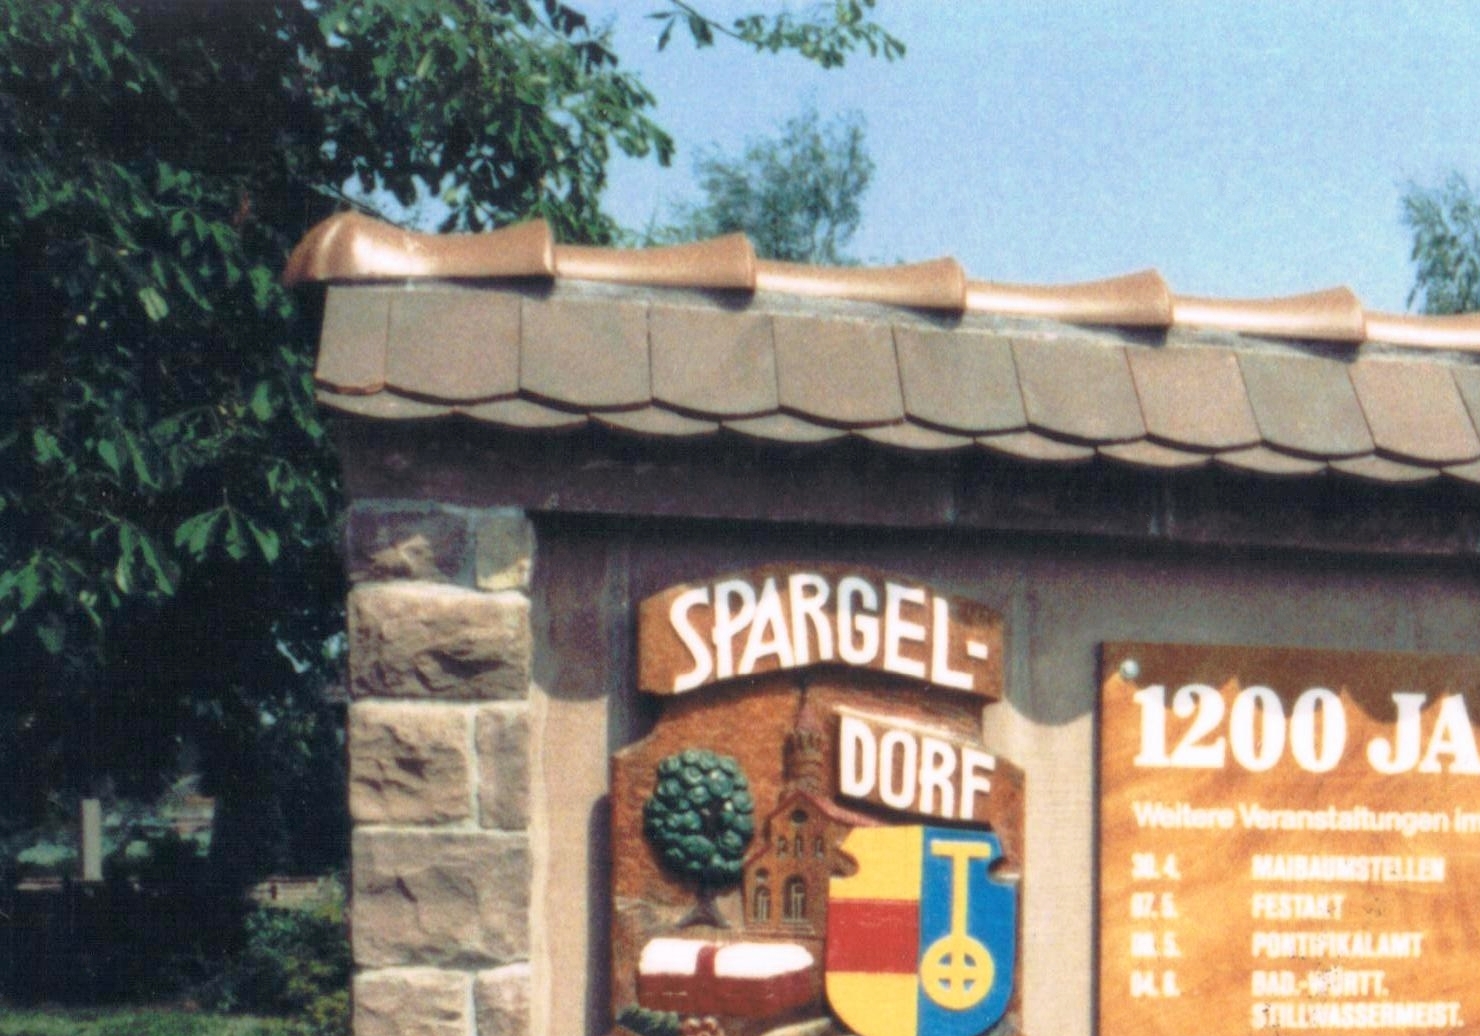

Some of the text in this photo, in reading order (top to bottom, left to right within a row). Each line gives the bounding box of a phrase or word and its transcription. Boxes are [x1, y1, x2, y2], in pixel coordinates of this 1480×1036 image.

[669, 573, 988, 692] SPARGEL-
[1132, 683, 1346, 773] 1200
[838, 715, 994, 819] DORF
[1133, 802, 1235, 828] Weitere
[1239, 804, 1450, 836] Veranstaltungen
[1252, 855, 1445, 882] MAIBAUMSTELLEN
[1252, 893, 1344, 919] FESTAKT
[1252, 932, 1423, 958] PONTIFIKALAMT
